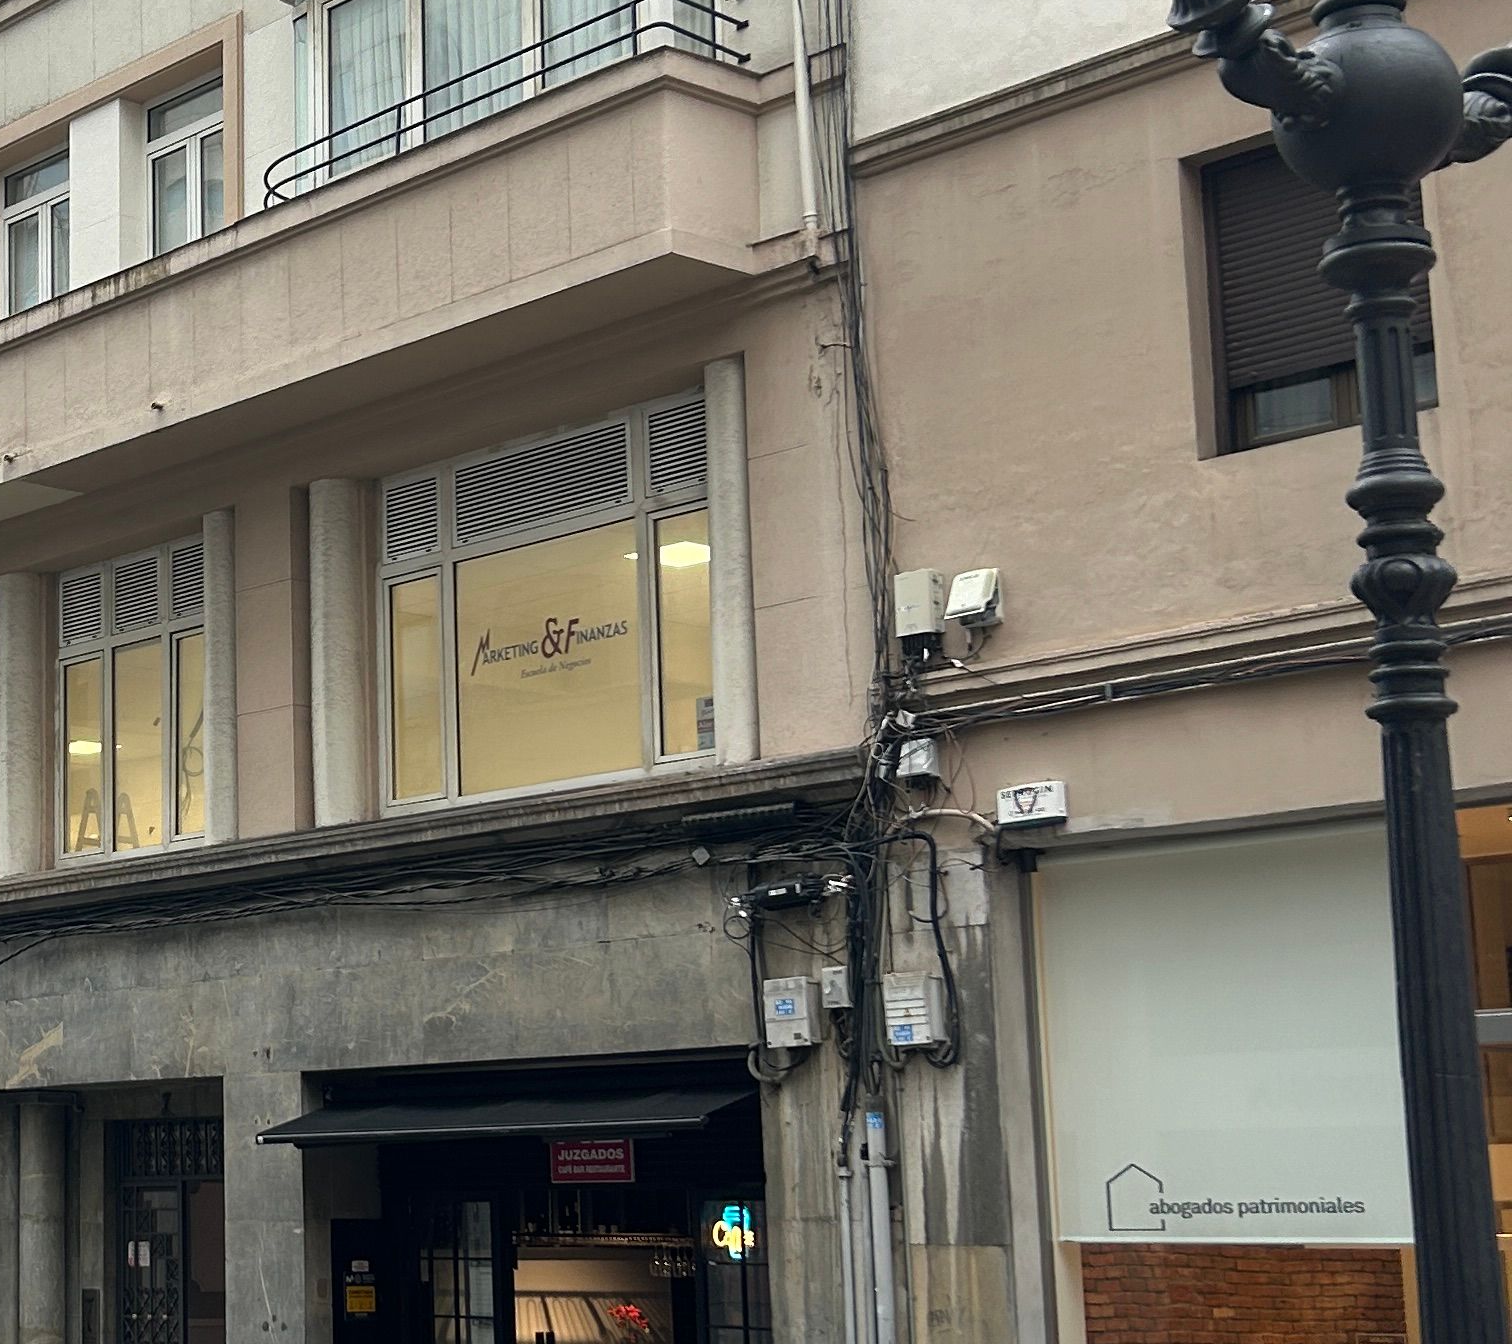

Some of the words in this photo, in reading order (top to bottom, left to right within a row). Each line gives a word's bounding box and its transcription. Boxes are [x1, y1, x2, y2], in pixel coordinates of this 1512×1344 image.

[471, 628, 538, 677] MARKETING
[541, 617, 564, 658] &
[565, 618, 627, 654] FINANZAS
[557, 1148, 624, 1161] JUZGADOS
[1149, 1198, 1234, 1219] abogados
[1237, 1197, 1366, 1218] patrimoniales
